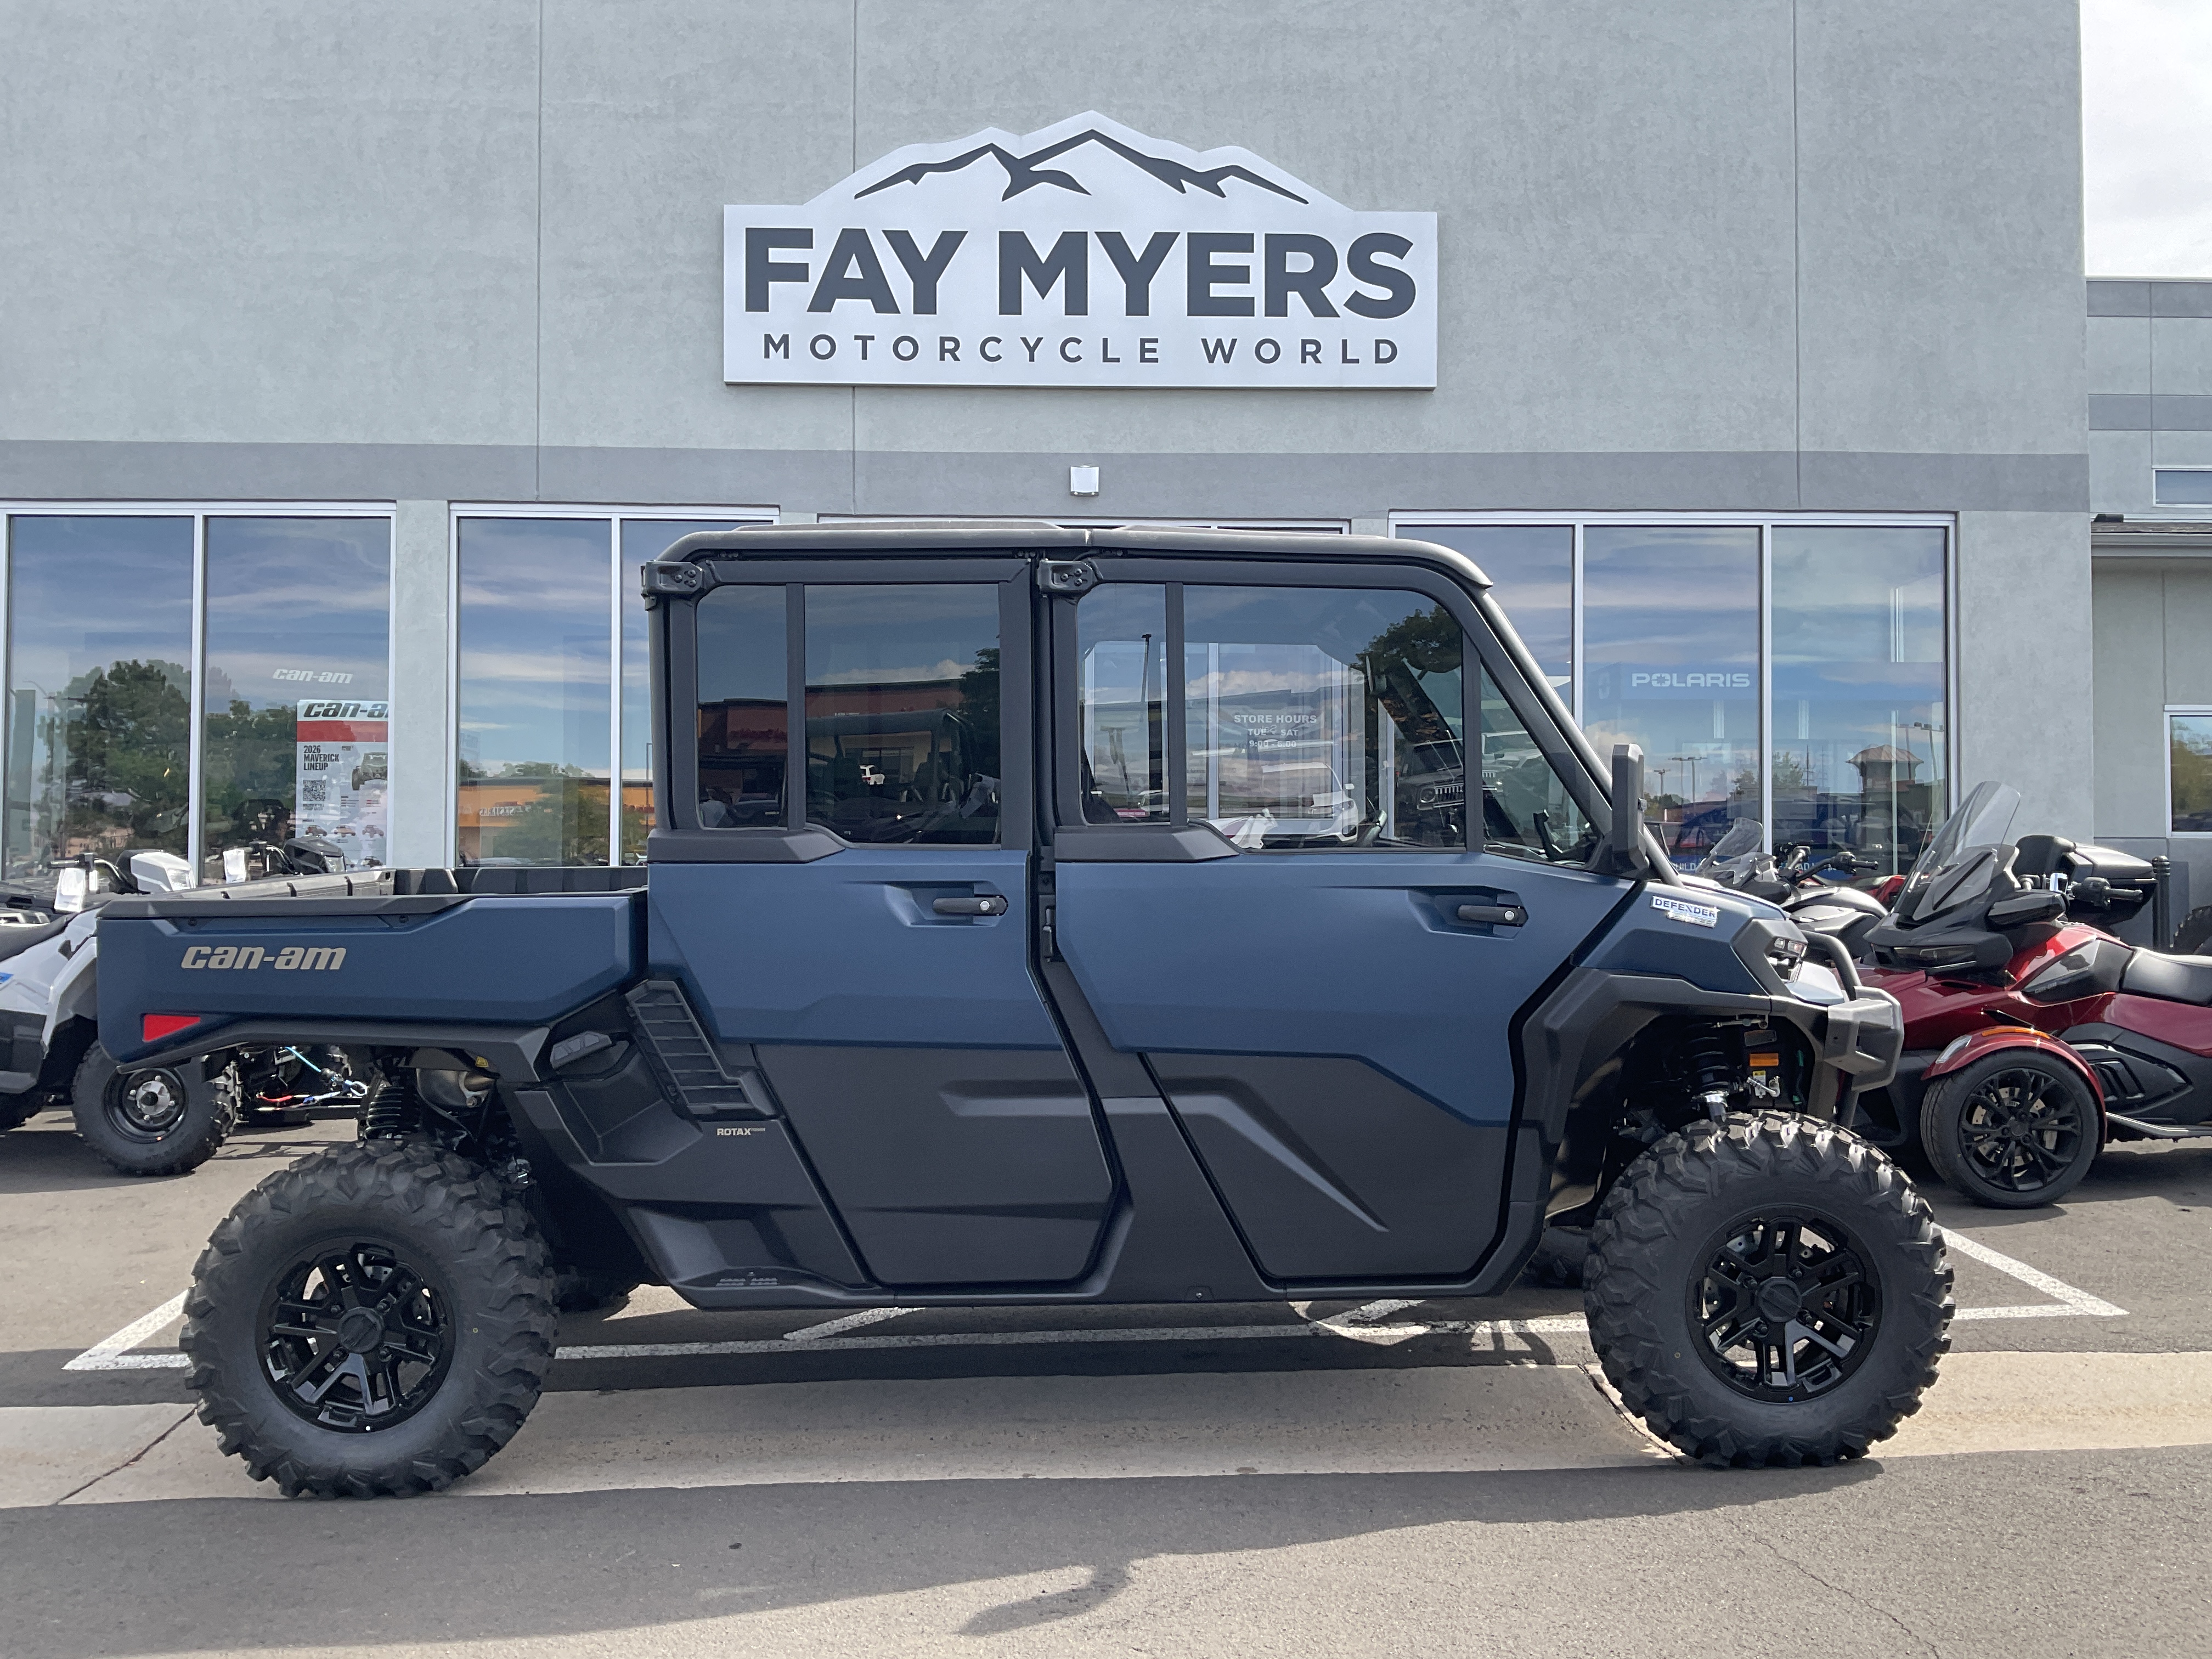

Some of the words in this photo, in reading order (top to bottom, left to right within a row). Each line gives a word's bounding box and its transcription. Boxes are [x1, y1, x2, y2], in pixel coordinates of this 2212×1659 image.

[746, 228, 968, 314] FAY
[999, 231, 1415, 319] MYERS
[764, 334, 1158, 363] MOTORCYCLE
[1201, 338, 1397, 364] WORLD
[273, 669, 353, 684] can-am
[1632, 673, 1750, 687] POLARIS
[303, 702, 388, 718] can-a
[1234, 715, 1272, 723] STORE
[1276, 715, 1317, 723] HOURS
[303, 745, 321, 753] 2026
[303, 754, 339, 762] MAVERICK
[1672, 863, 1696, 871] UILD
[1655, 899, 1715, 918] DEFENDER
[181, 946, 346, 970] can-am
